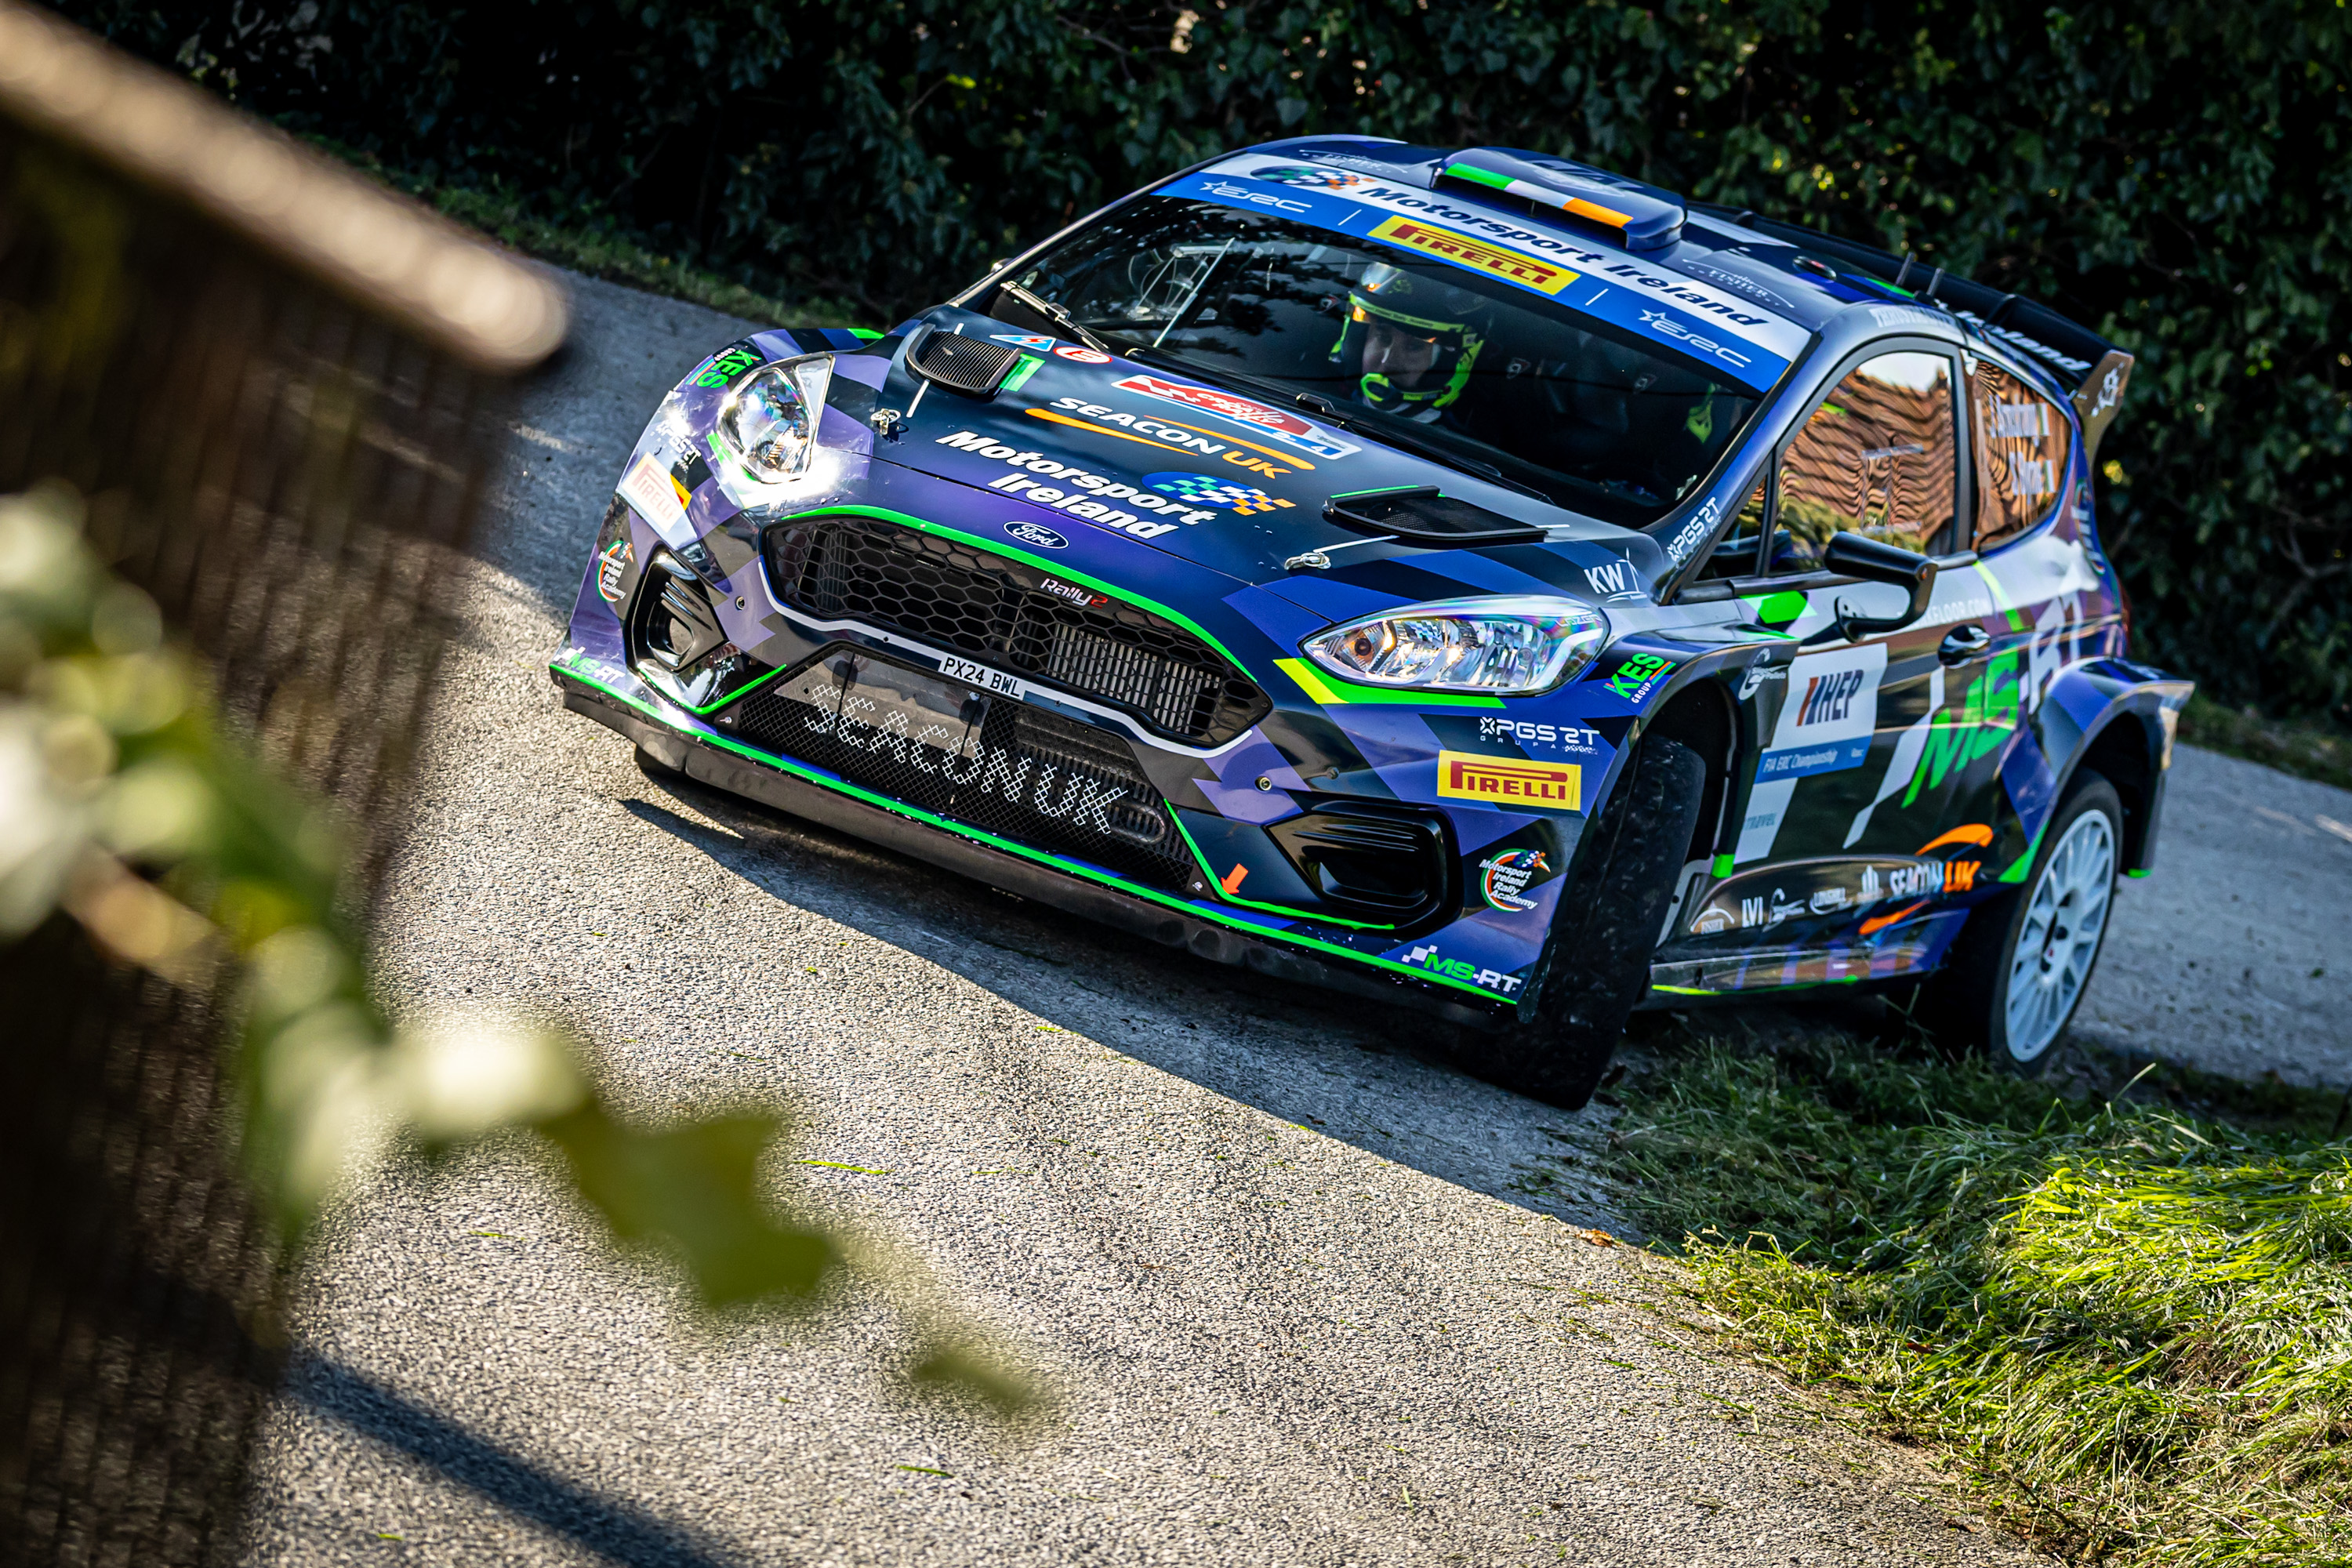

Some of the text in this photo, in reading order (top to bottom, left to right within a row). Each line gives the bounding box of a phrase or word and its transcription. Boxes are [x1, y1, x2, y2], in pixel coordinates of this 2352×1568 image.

[1358, 187, 1606, 263] Motorsport
[1602, 264, 1769, 326] Ireland
[1389, 223, 1557, 285] PIRELLI
[696, 349, 754, 389] KES
[1049, 397, 1292, 479] SEACON UK
[632, 463, 684, 521] PIRELLI
[935, 430, 1219, 526] Motorsport
[987, 472, 1179, 539] Ireland
[1012, 524, 1059, 546] Ford
[1584, 563, 1625, 593] KW
[942, 657, 1019, 698] PX24 BWL
[1607, 653, 1666, 699] KES
[1631, 681, 1653, 704] GROUP
[804, 684, 1129, 835] SEACON UK
[1450, 760, 1568, 800] PIRELLI
[1479, 858, 1532, 880] Motorsport
[1492, 872, 1527, 887] Ireland
[1493, 881, 1521, 896] Rally
[1490, 889, 1538, 910] Academy
[1423, 953, 1523, 993] MS-RT
